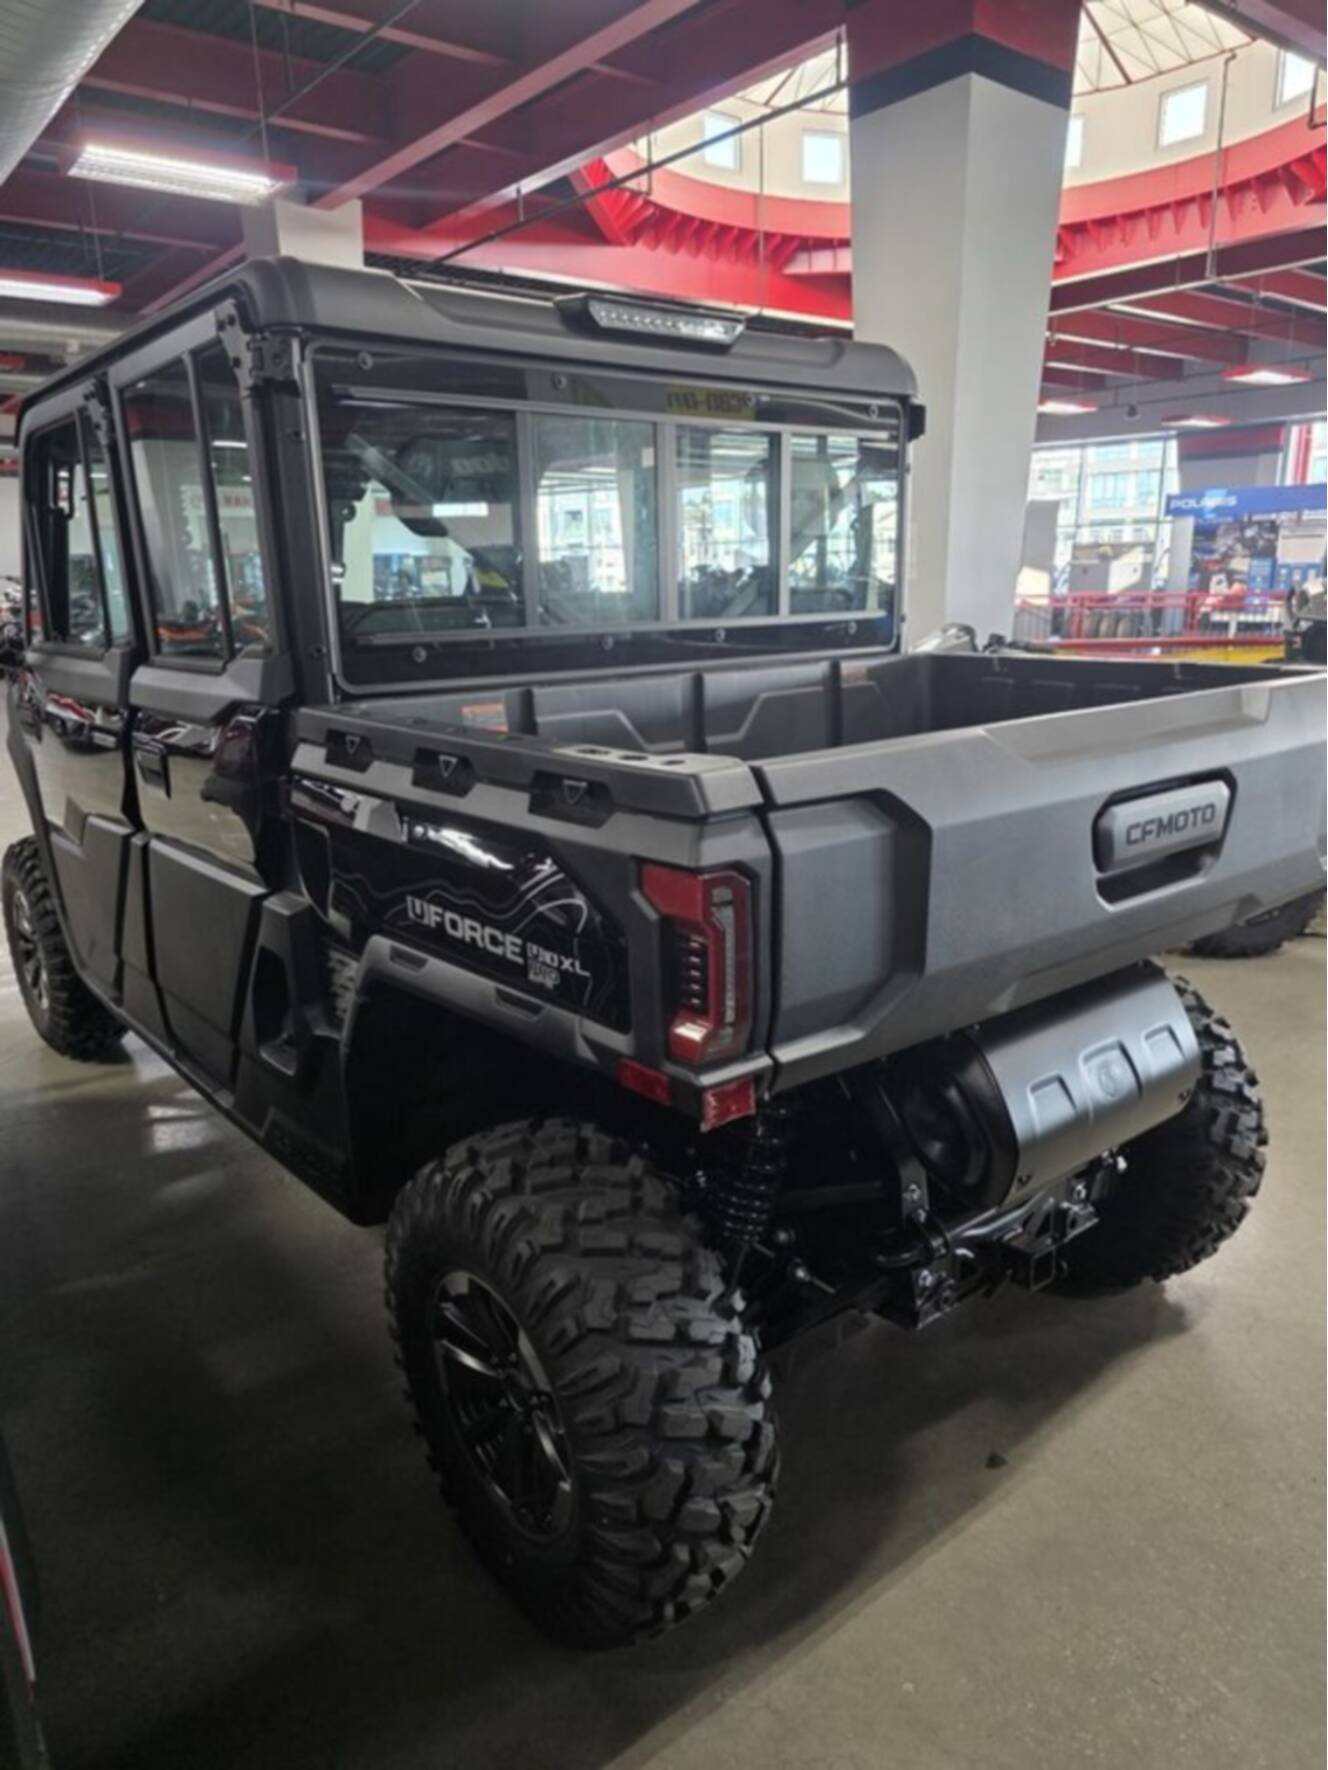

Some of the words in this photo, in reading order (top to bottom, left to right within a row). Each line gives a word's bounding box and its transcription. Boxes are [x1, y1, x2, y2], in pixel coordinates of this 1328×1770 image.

[1169, 496, 1238, 510] POLS
[1126, 803, 1216, 845] CFMOTO
[406, 895, 524, 965] UFORCE
